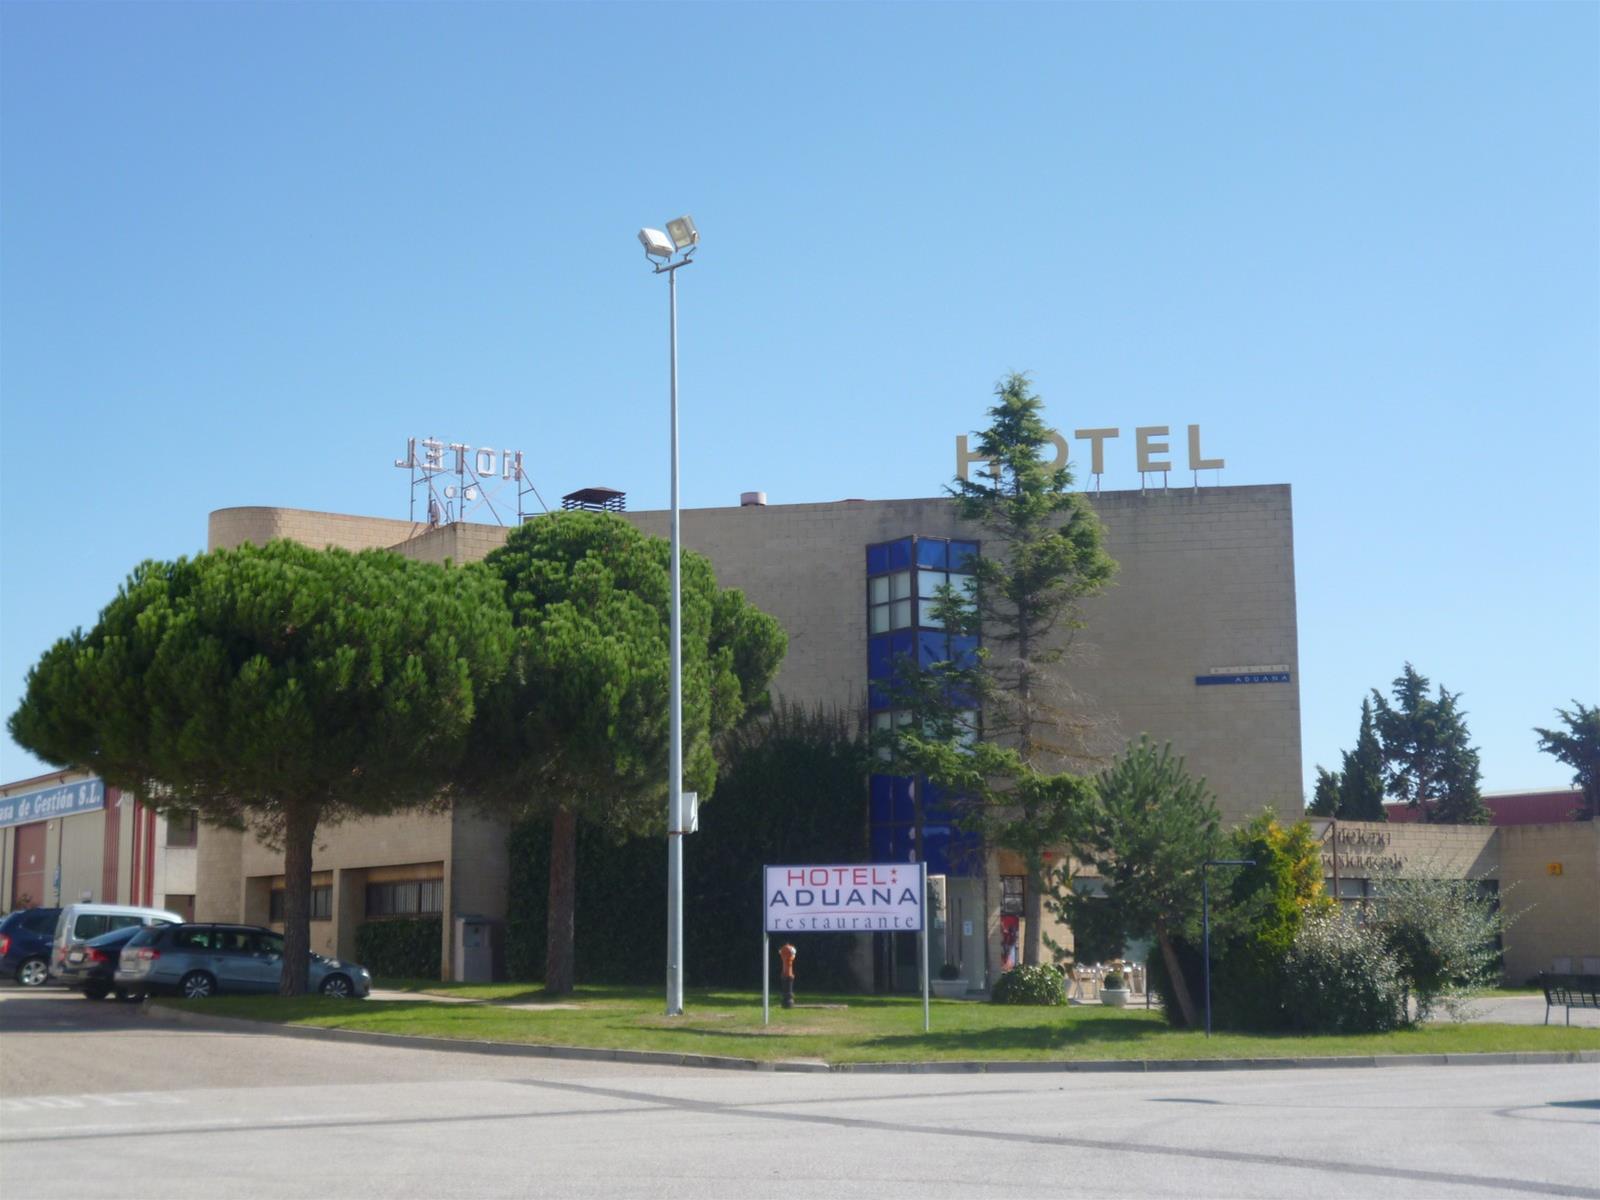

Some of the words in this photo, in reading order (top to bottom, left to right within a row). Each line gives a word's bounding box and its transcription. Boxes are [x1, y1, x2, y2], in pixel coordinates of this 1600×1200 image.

[18, 799, 31, 817] de
[34, 788, 74, 814] Gestión
[79, 783, 100, 805] S.L.
[787, 868, 887, 886] HOTEL
[769, 888, 918, 907] ADUANA
[774, 916, 914, 929] restaurante
